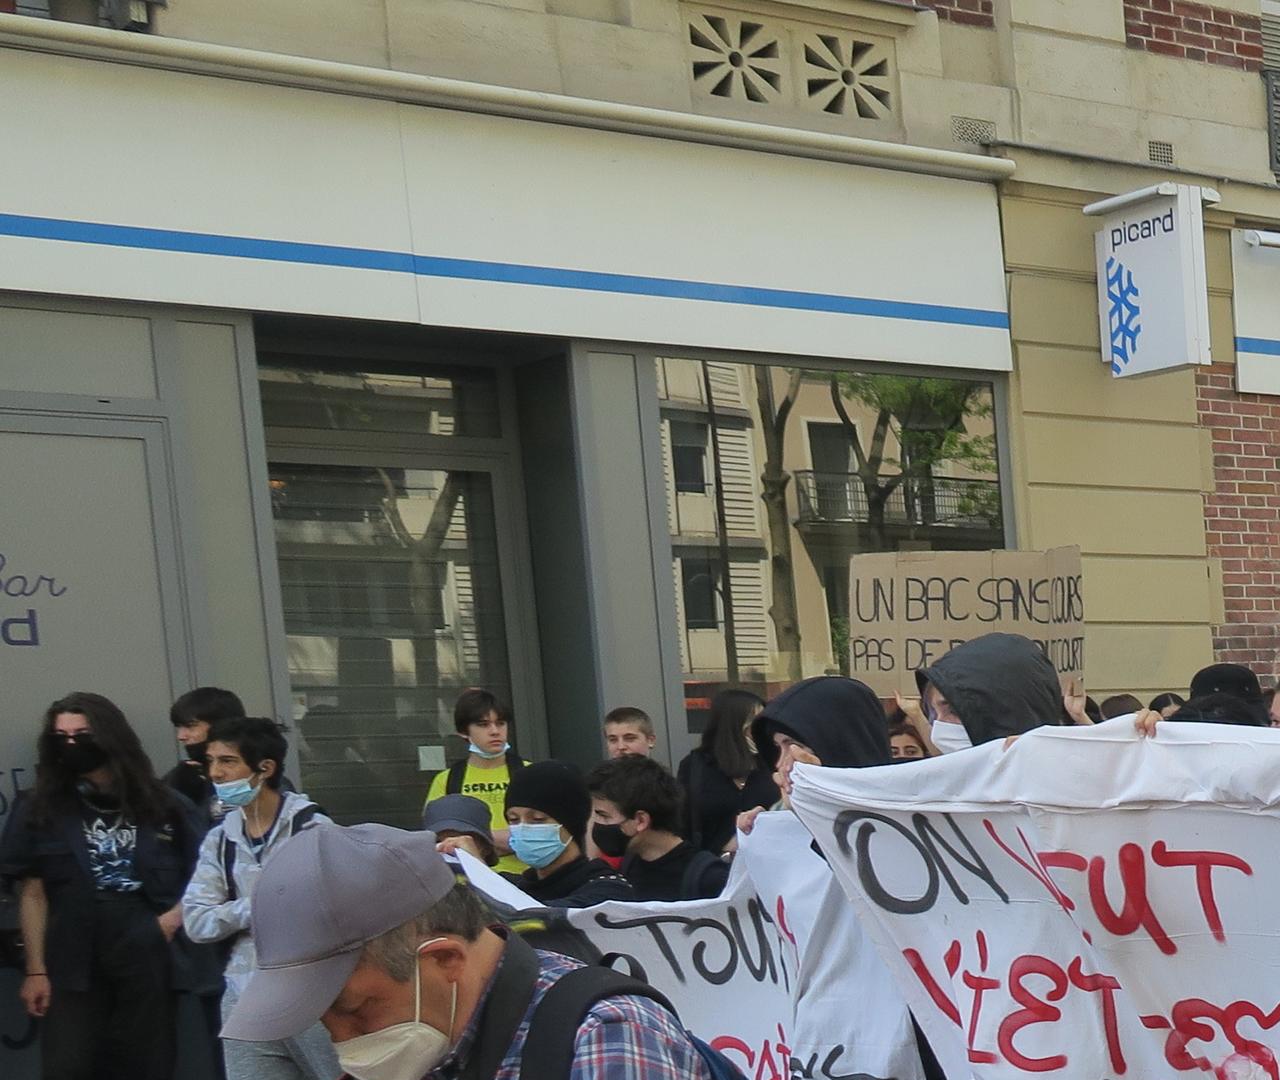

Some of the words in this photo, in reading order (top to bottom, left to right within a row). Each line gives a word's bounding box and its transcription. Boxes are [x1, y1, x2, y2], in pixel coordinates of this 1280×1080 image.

[1111, 208, 1174, 252] picard
[856, 578, 894, 622] UN
[906, 577, 970, 622] BAC
[976, 577, 1049, 624] SANS
[853, 638, 895, 671] PAS
[905, 638, 942, 670] DE
[833, 810, 1009, 914] ON
